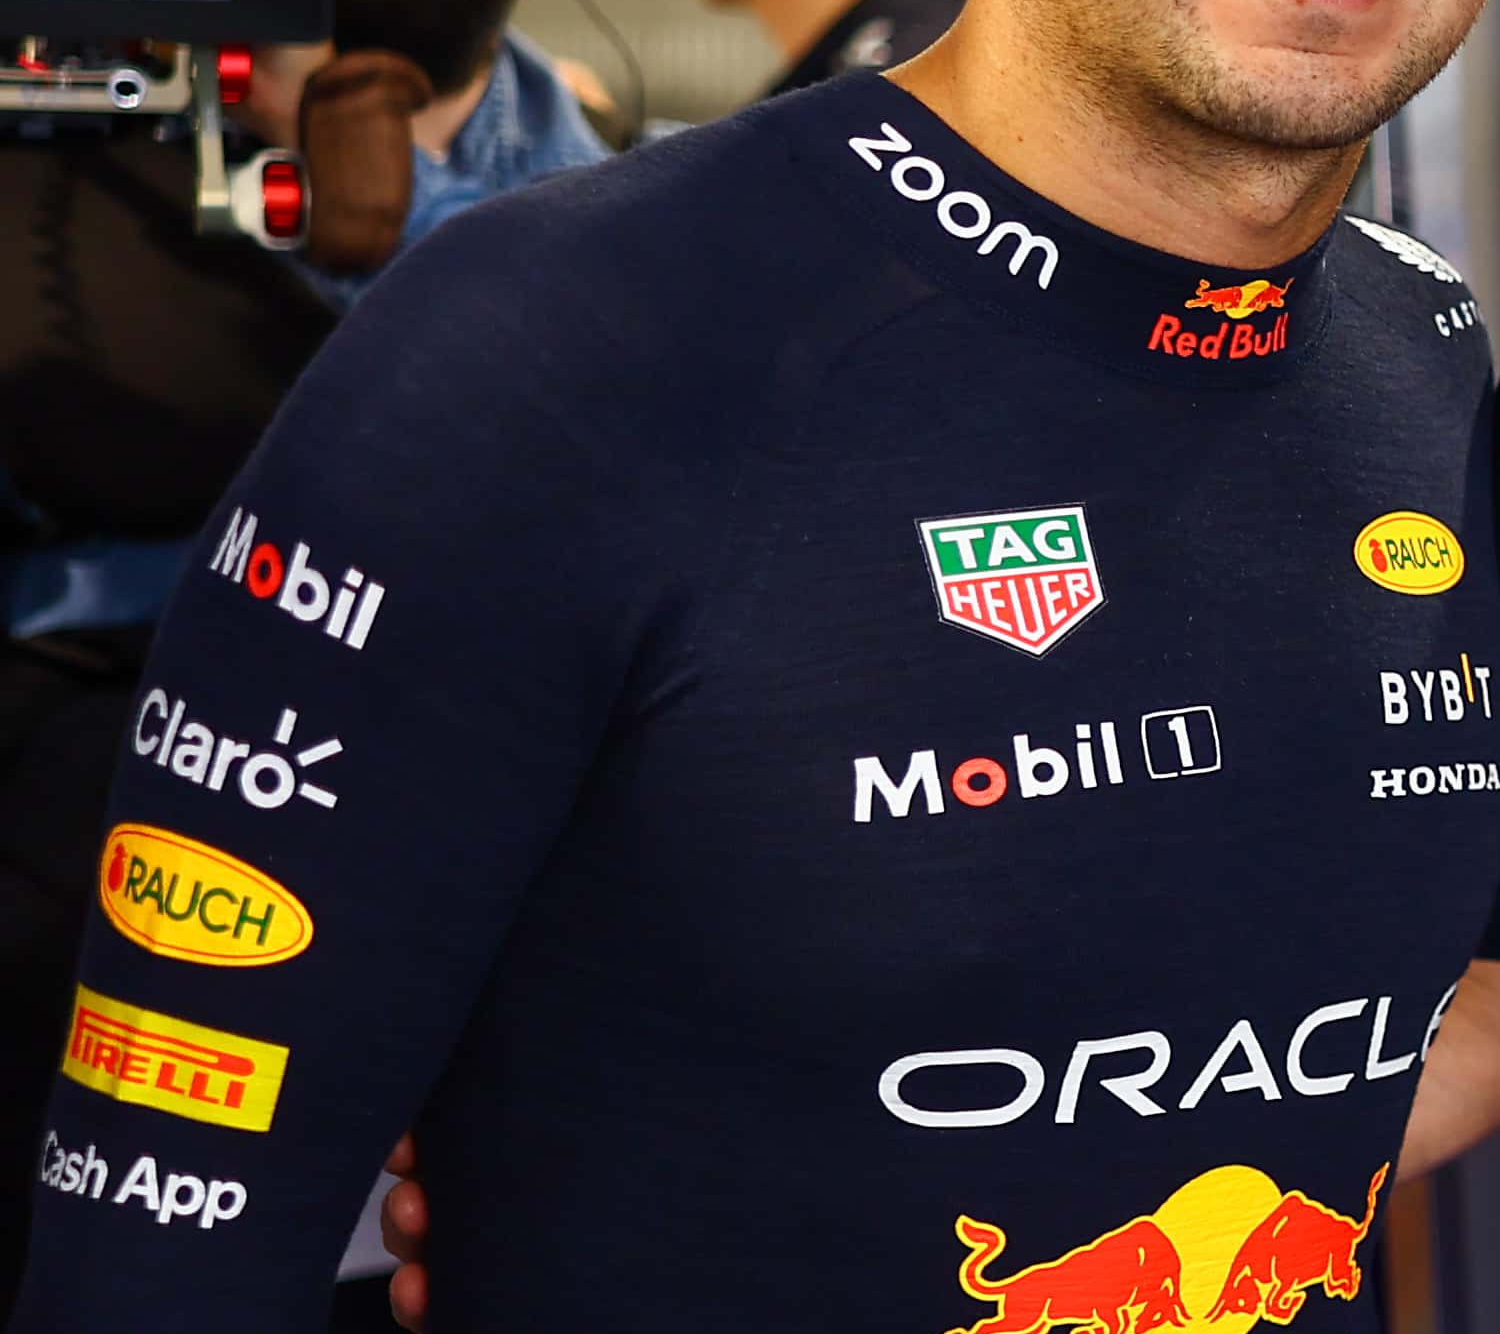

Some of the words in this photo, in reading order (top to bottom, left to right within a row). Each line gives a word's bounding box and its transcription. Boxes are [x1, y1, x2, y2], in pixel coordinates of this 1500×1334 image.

[849, 123, 1058, 289] zoom
[1147, 312, 1224, 361] Red
[1228, 314, 1288, 360] Bull
[211, 508, 384, 649] Mobil
[938, 519, 1078, 569] TAG
[1386, 536, 1453, 571] RAUCH
[949, 571, 1095, 641] HEUER
[1381, 654, 1491, 724] BYBIT
[134, 687, 297, 809] Claro
[854, 722, 1123, 822] Mobil
[1167, 716, 1195, 768] 1
[1371, 764, 1500, 798] HONDA
[123, 854, 277, 948] RAUCH
[70, 1006, 256, 1109] PIRELLI
[41, 1129, 109, 1201] Cash
[114, 1155, 248, 1229] App
